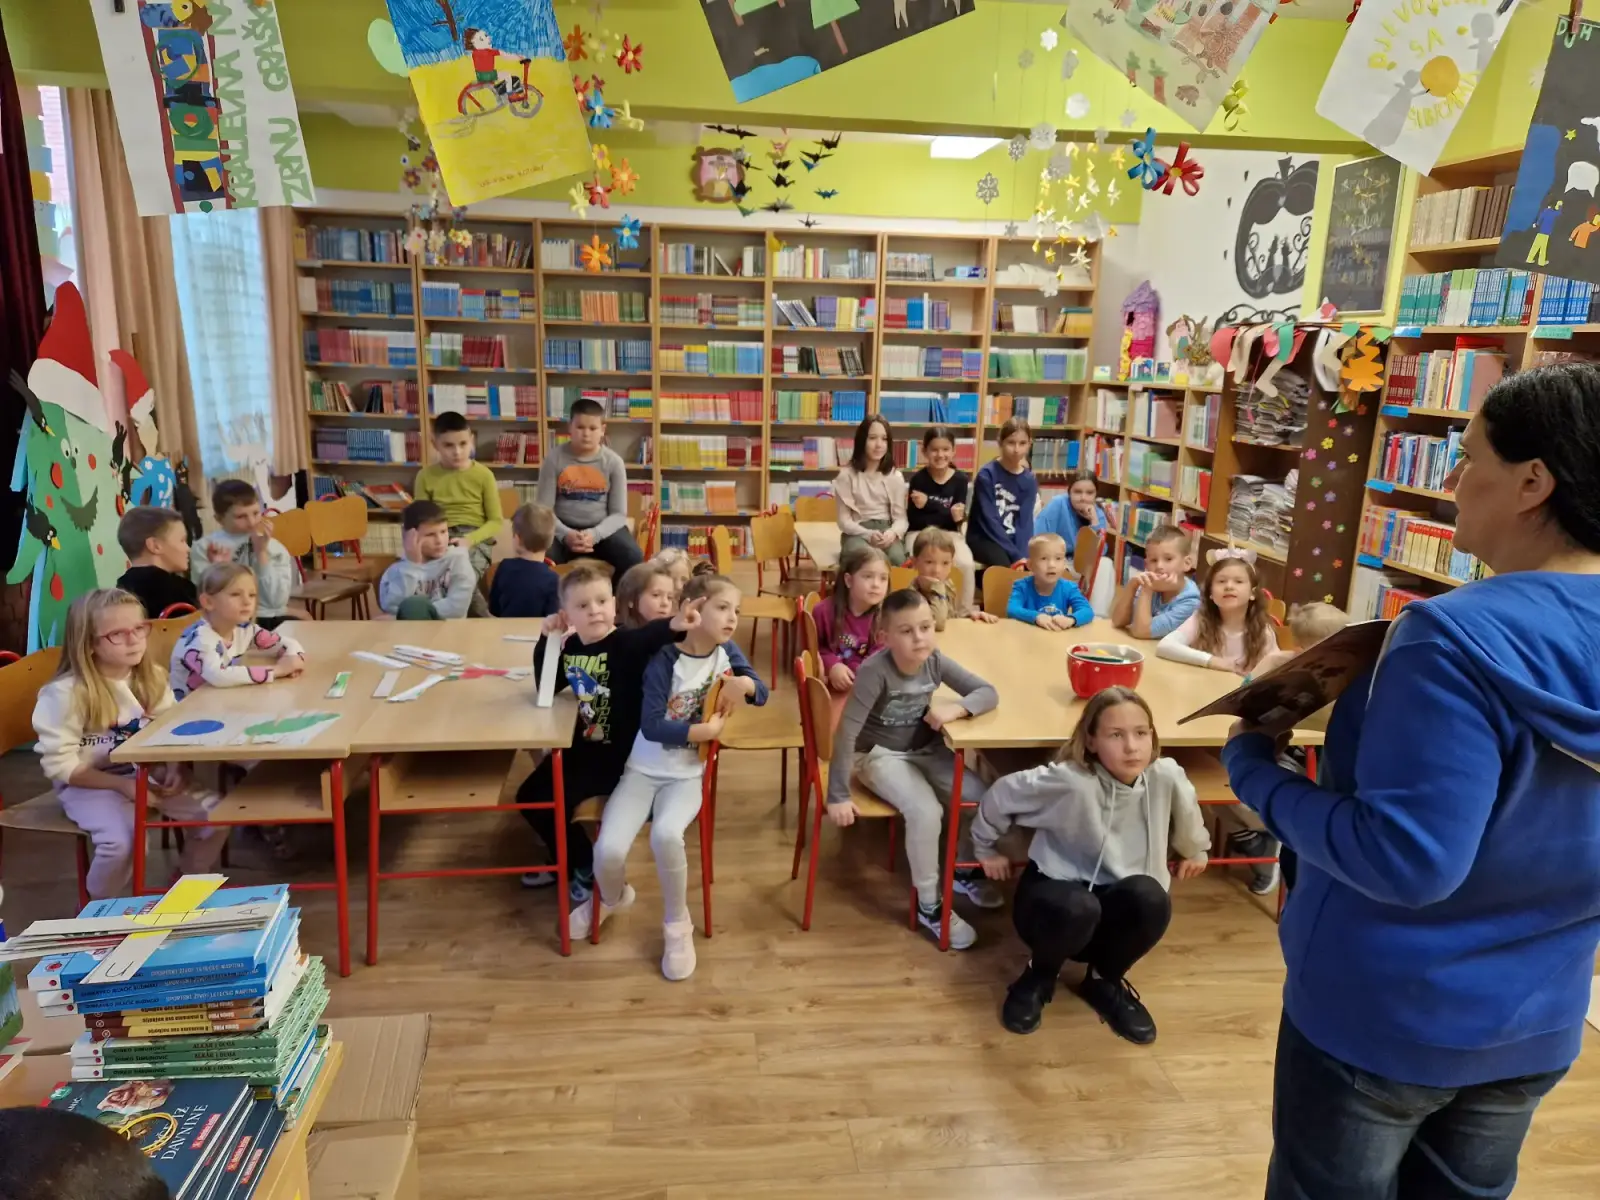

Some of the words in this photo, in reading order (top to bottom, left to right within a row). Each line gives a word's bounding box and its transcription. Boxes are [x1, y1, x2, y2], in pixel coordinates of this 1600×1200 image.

[241, 0, 289, 92] GRAŠK
[213, 49, 258, 208] KRALJEVNA
[268, 117, 313, 206] ZRNU
[161, 1104, 208, 1160] DAVNINE
[173, 1106, 191, 1119] IZ
